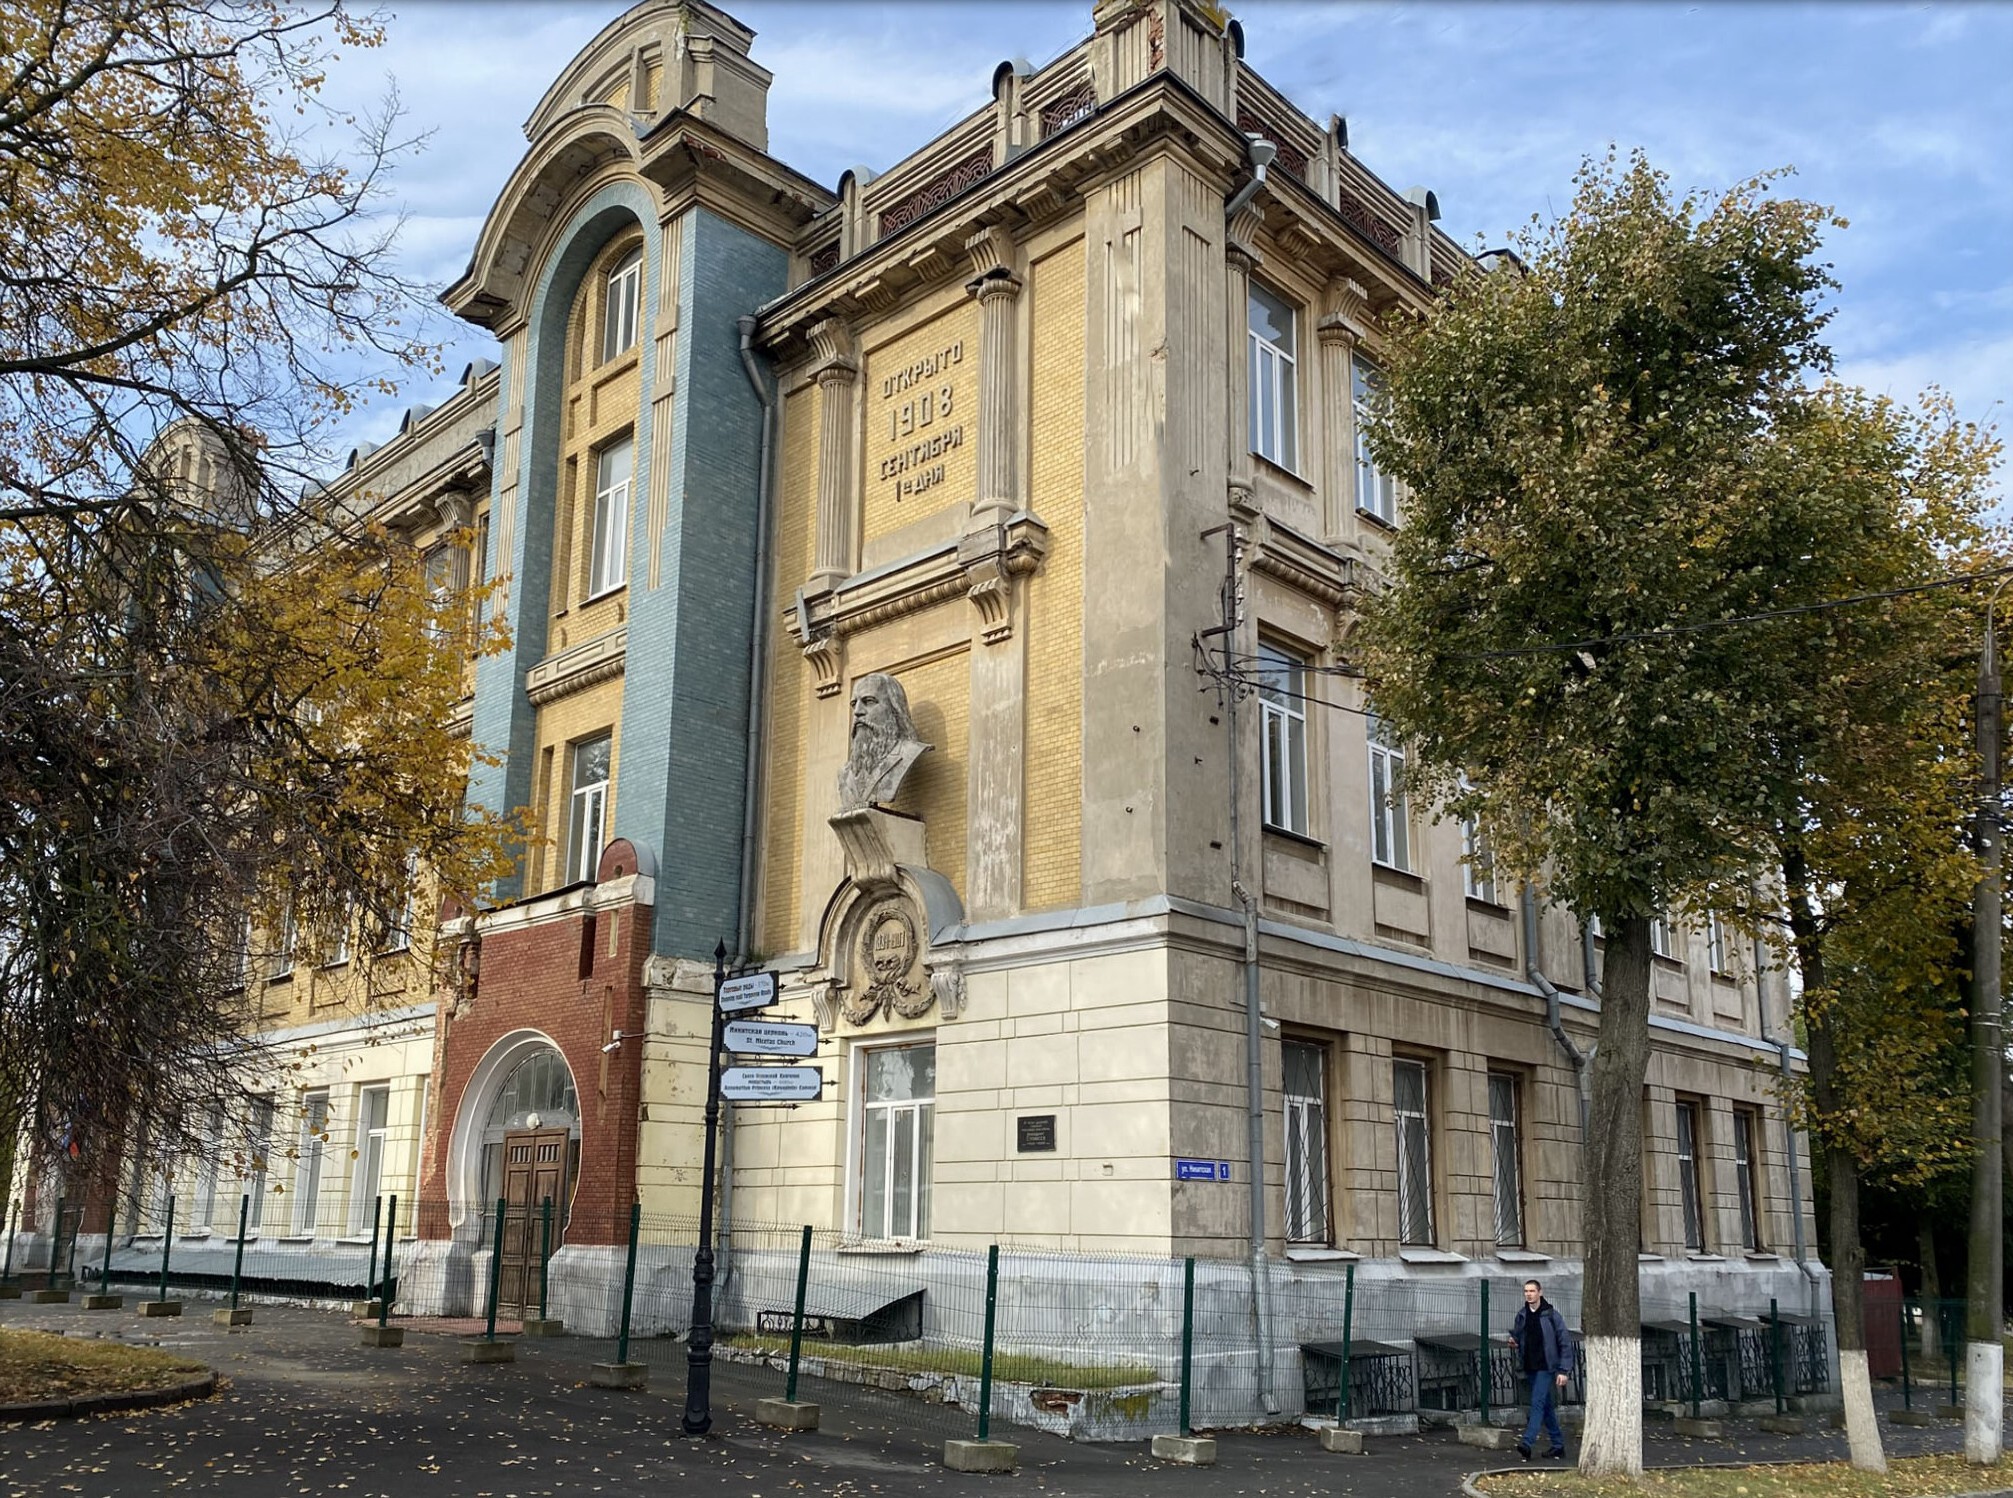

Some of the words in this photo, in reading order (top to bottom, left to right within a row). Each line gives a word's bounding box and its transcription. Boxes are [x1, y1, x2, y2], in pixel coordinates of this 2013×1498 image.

[883, 340, 963, 399] ОТКРЫТО
[890, 385, 953, 441] 1908
[880, 425, 964, 481] СЕНТЯБРЯ
[914, 464, 945, 495] ДНЯ
